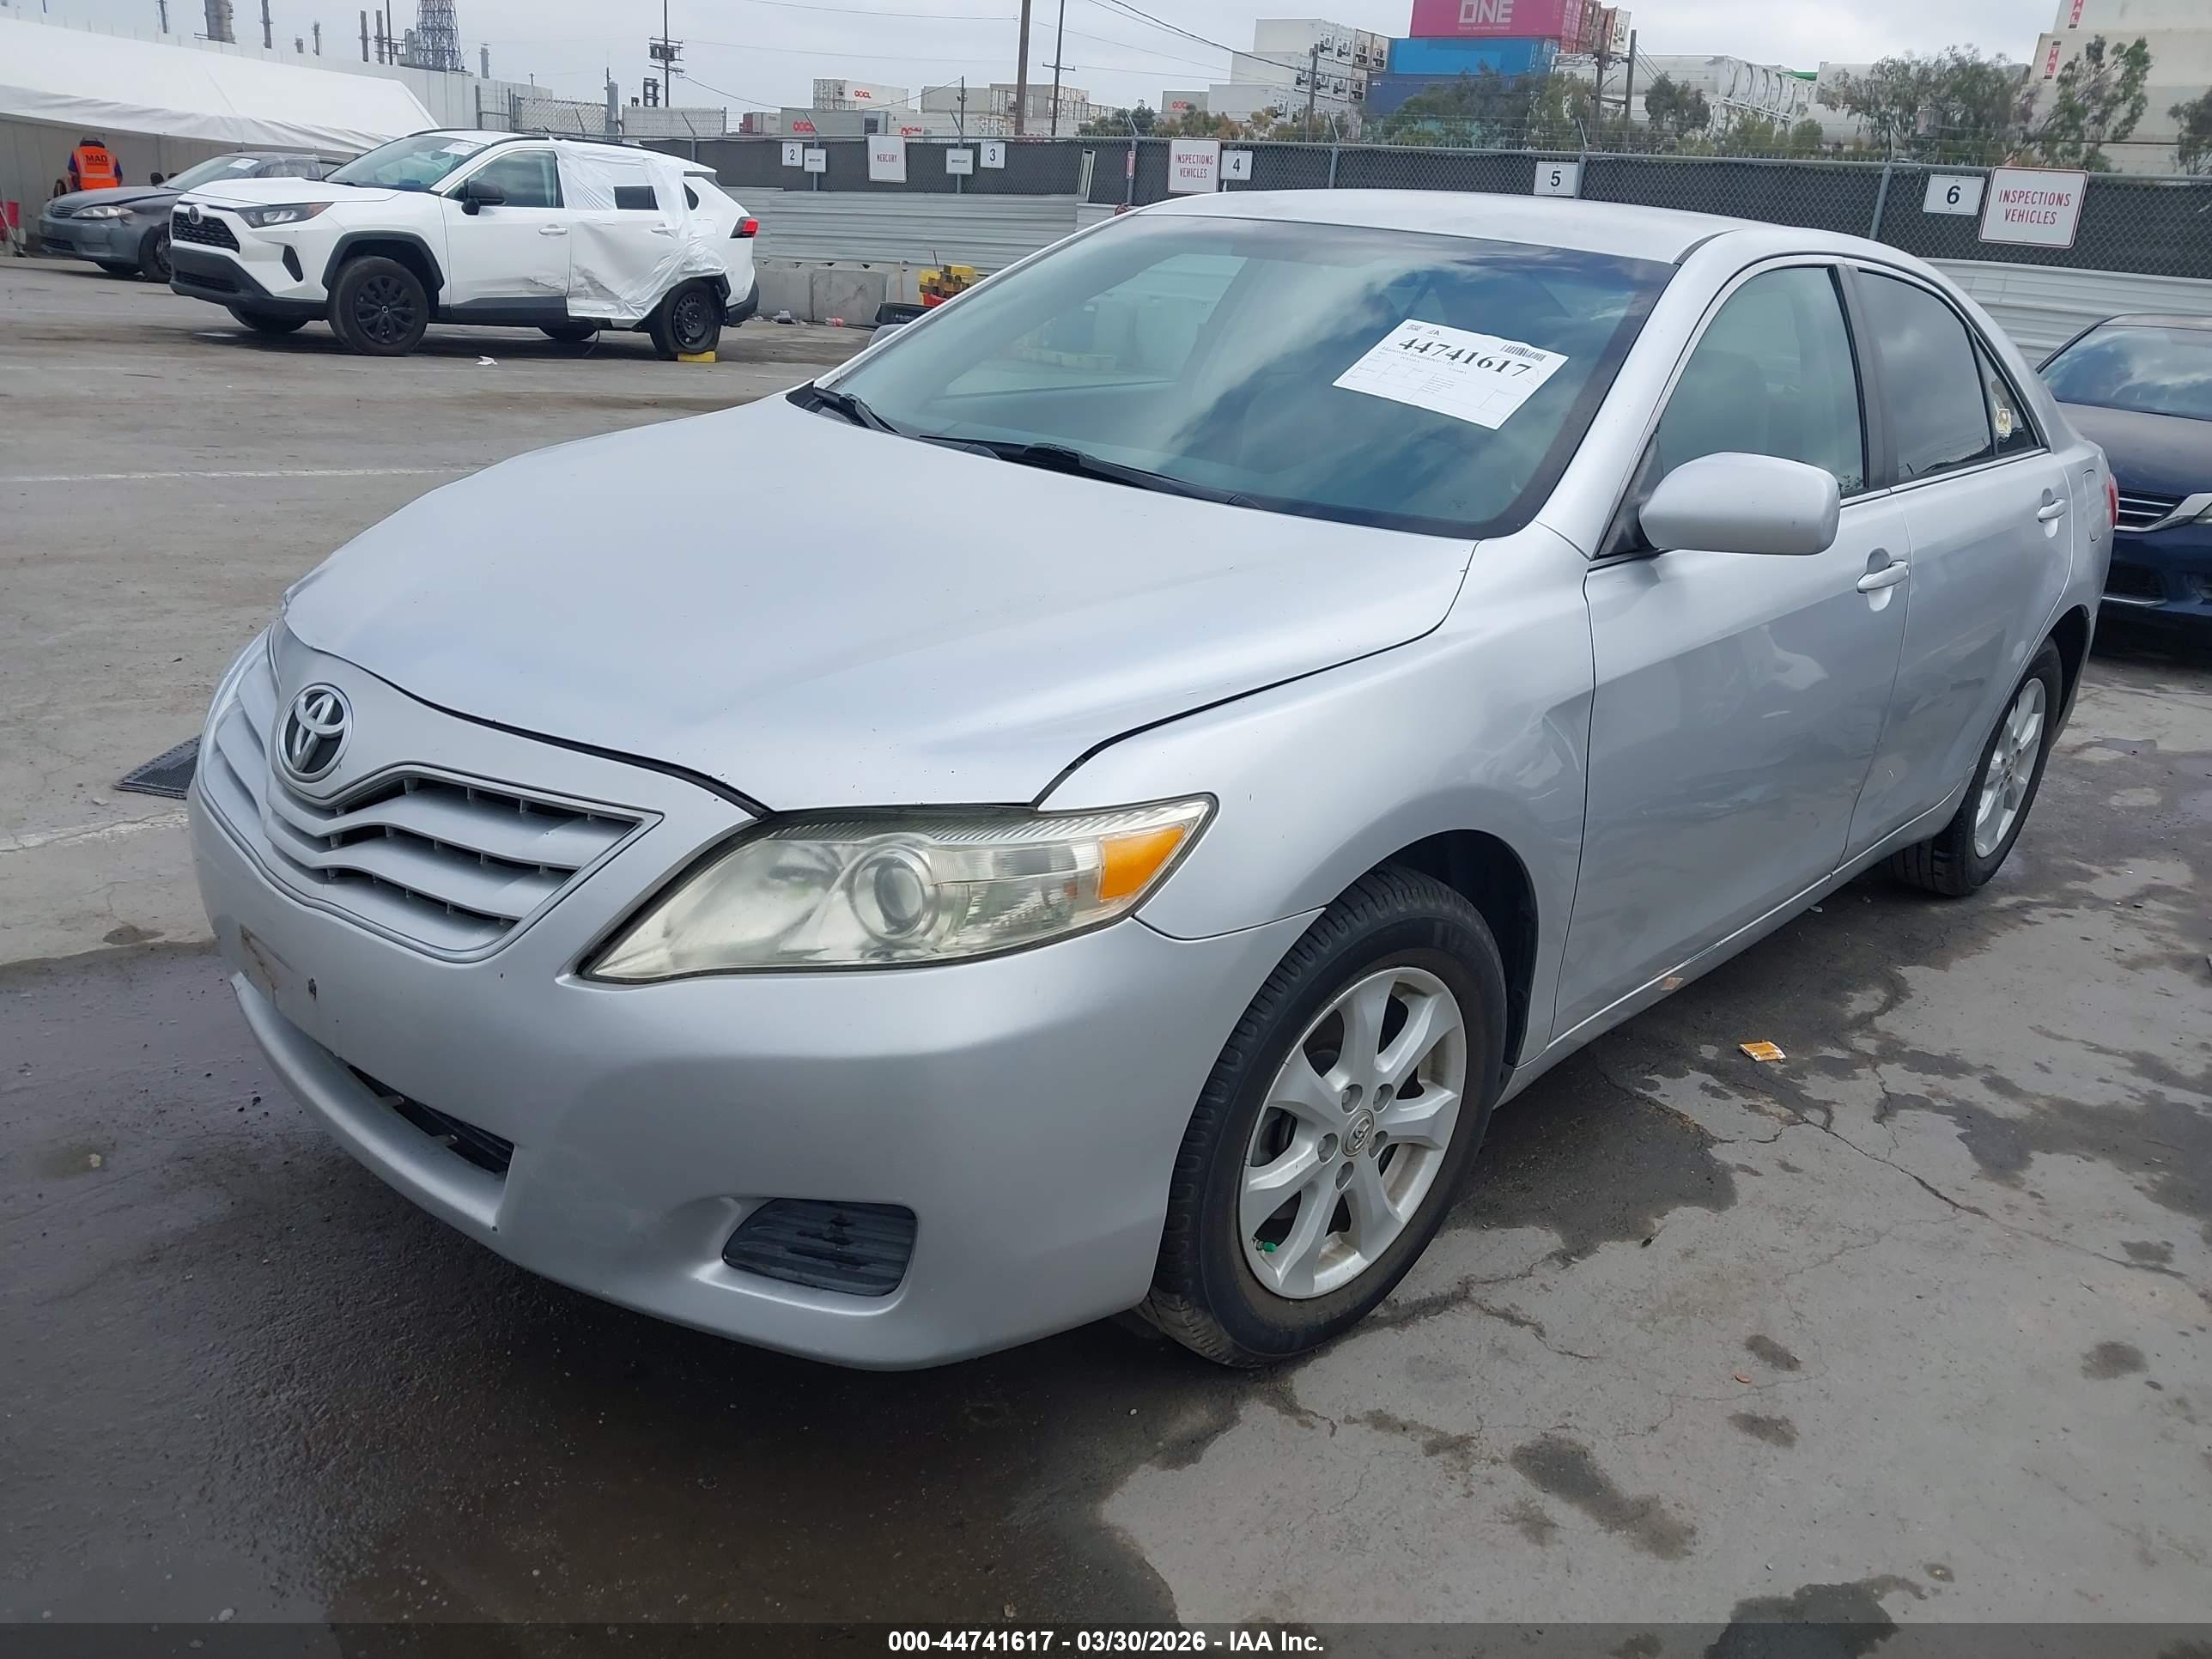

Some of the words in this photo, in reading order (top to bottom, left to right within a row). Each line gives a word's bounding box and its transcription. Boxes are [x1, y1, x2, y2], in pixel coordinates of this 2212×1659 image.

[1458, 0, 1515, 23] ONE
[789, 149, 795, 161] 2
[877, 154, 897, 163] MERCURY
[989, 148, 996, 161] 3
[1175, 153, 1214, 166] INSPECTIONS
[1179, 167, 1207, 179] VEHICLES
[1232, 157, 1241, 173] 4
[1550, 170, 1561, 187] 5
[1946, 185, 1961, 205] 6
[1998, 189, 2072, 207] INSPECTIONS
[2004, 209, 2057, 225] VEHICLES
[1398, 337, 1533, 377] 44741617
